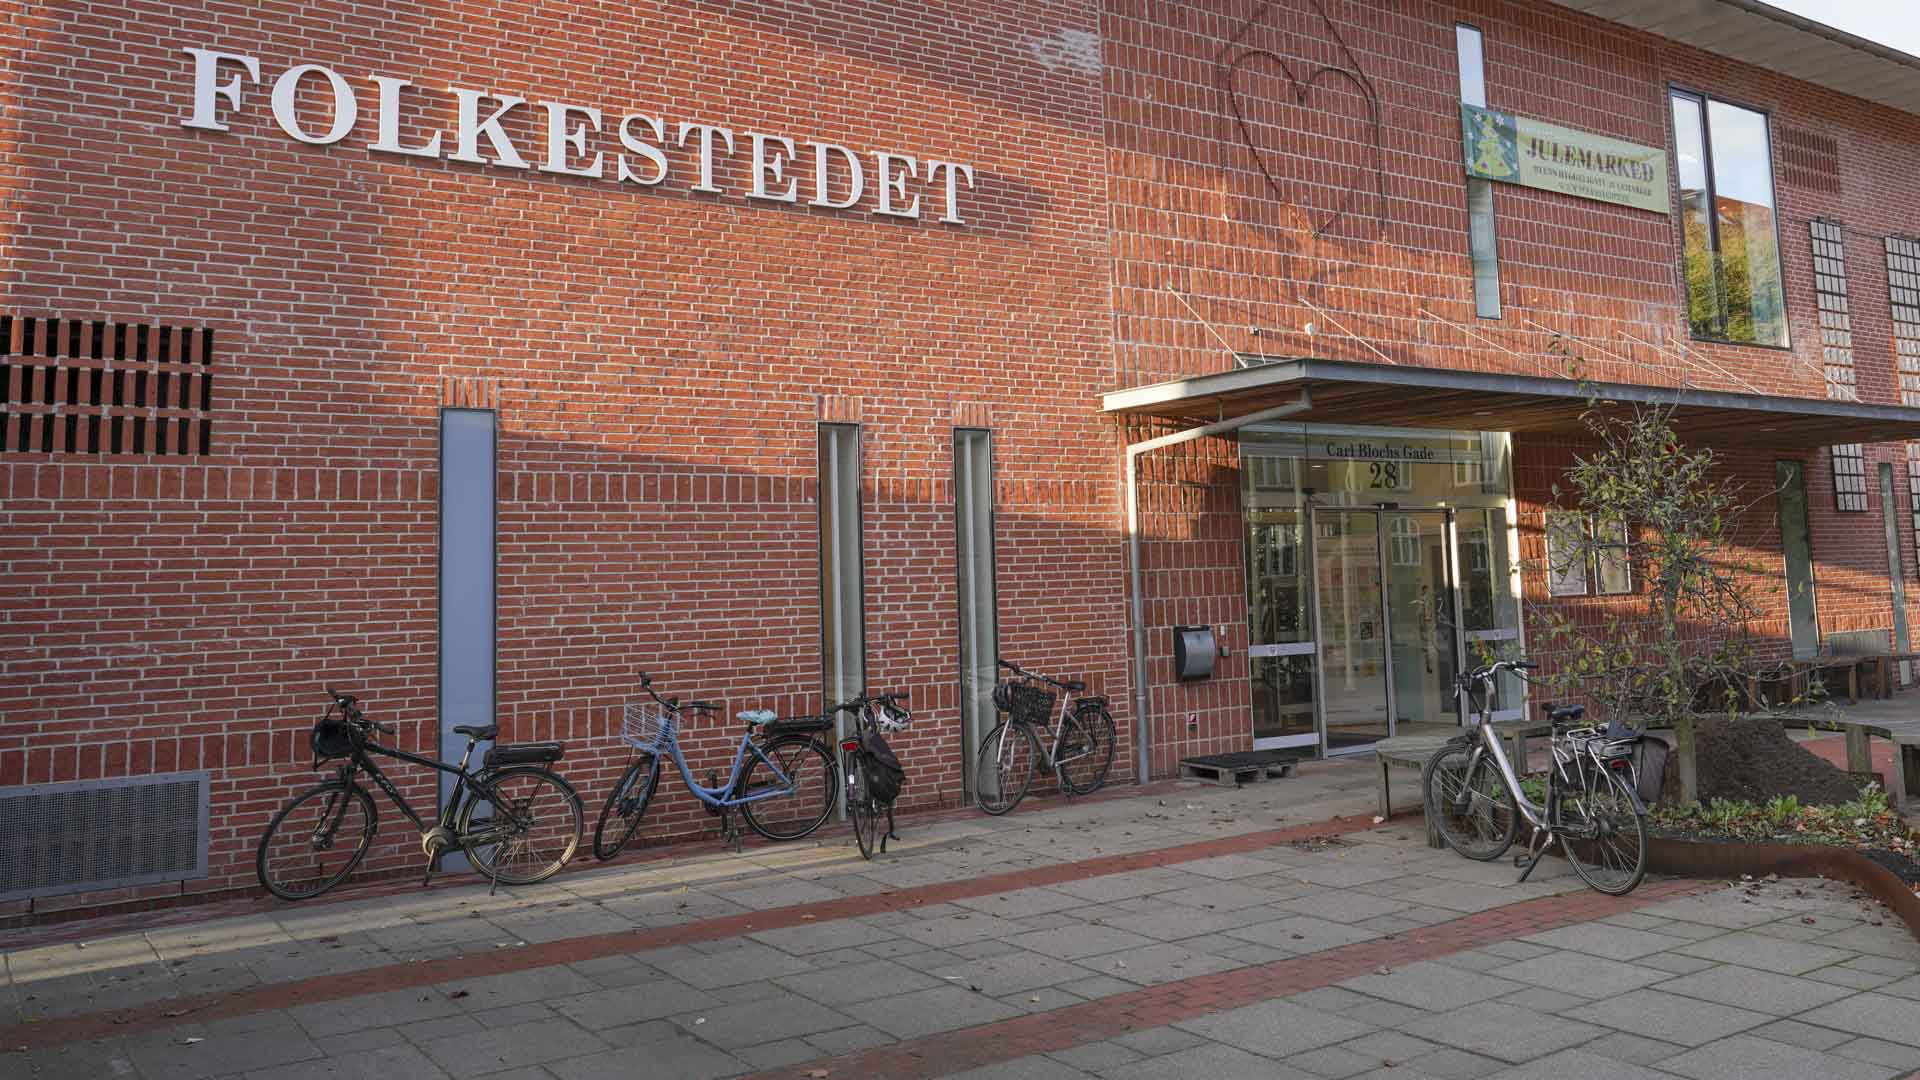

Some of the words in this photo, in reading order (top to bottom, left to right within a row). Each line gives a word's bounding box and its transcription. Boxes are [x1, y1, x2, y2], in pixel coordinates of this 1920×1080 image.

[179, 46, 975, 225] FOLKESTEDET
[1526, 136, 1655, 183] JULEMARKED
[1326, 442, 1354, 458] Carl
[1359, 443, 1400, 460] Blochs
[1403, 446, 1435, 461] Gade
[1369, 462, 1398, 489] 28
